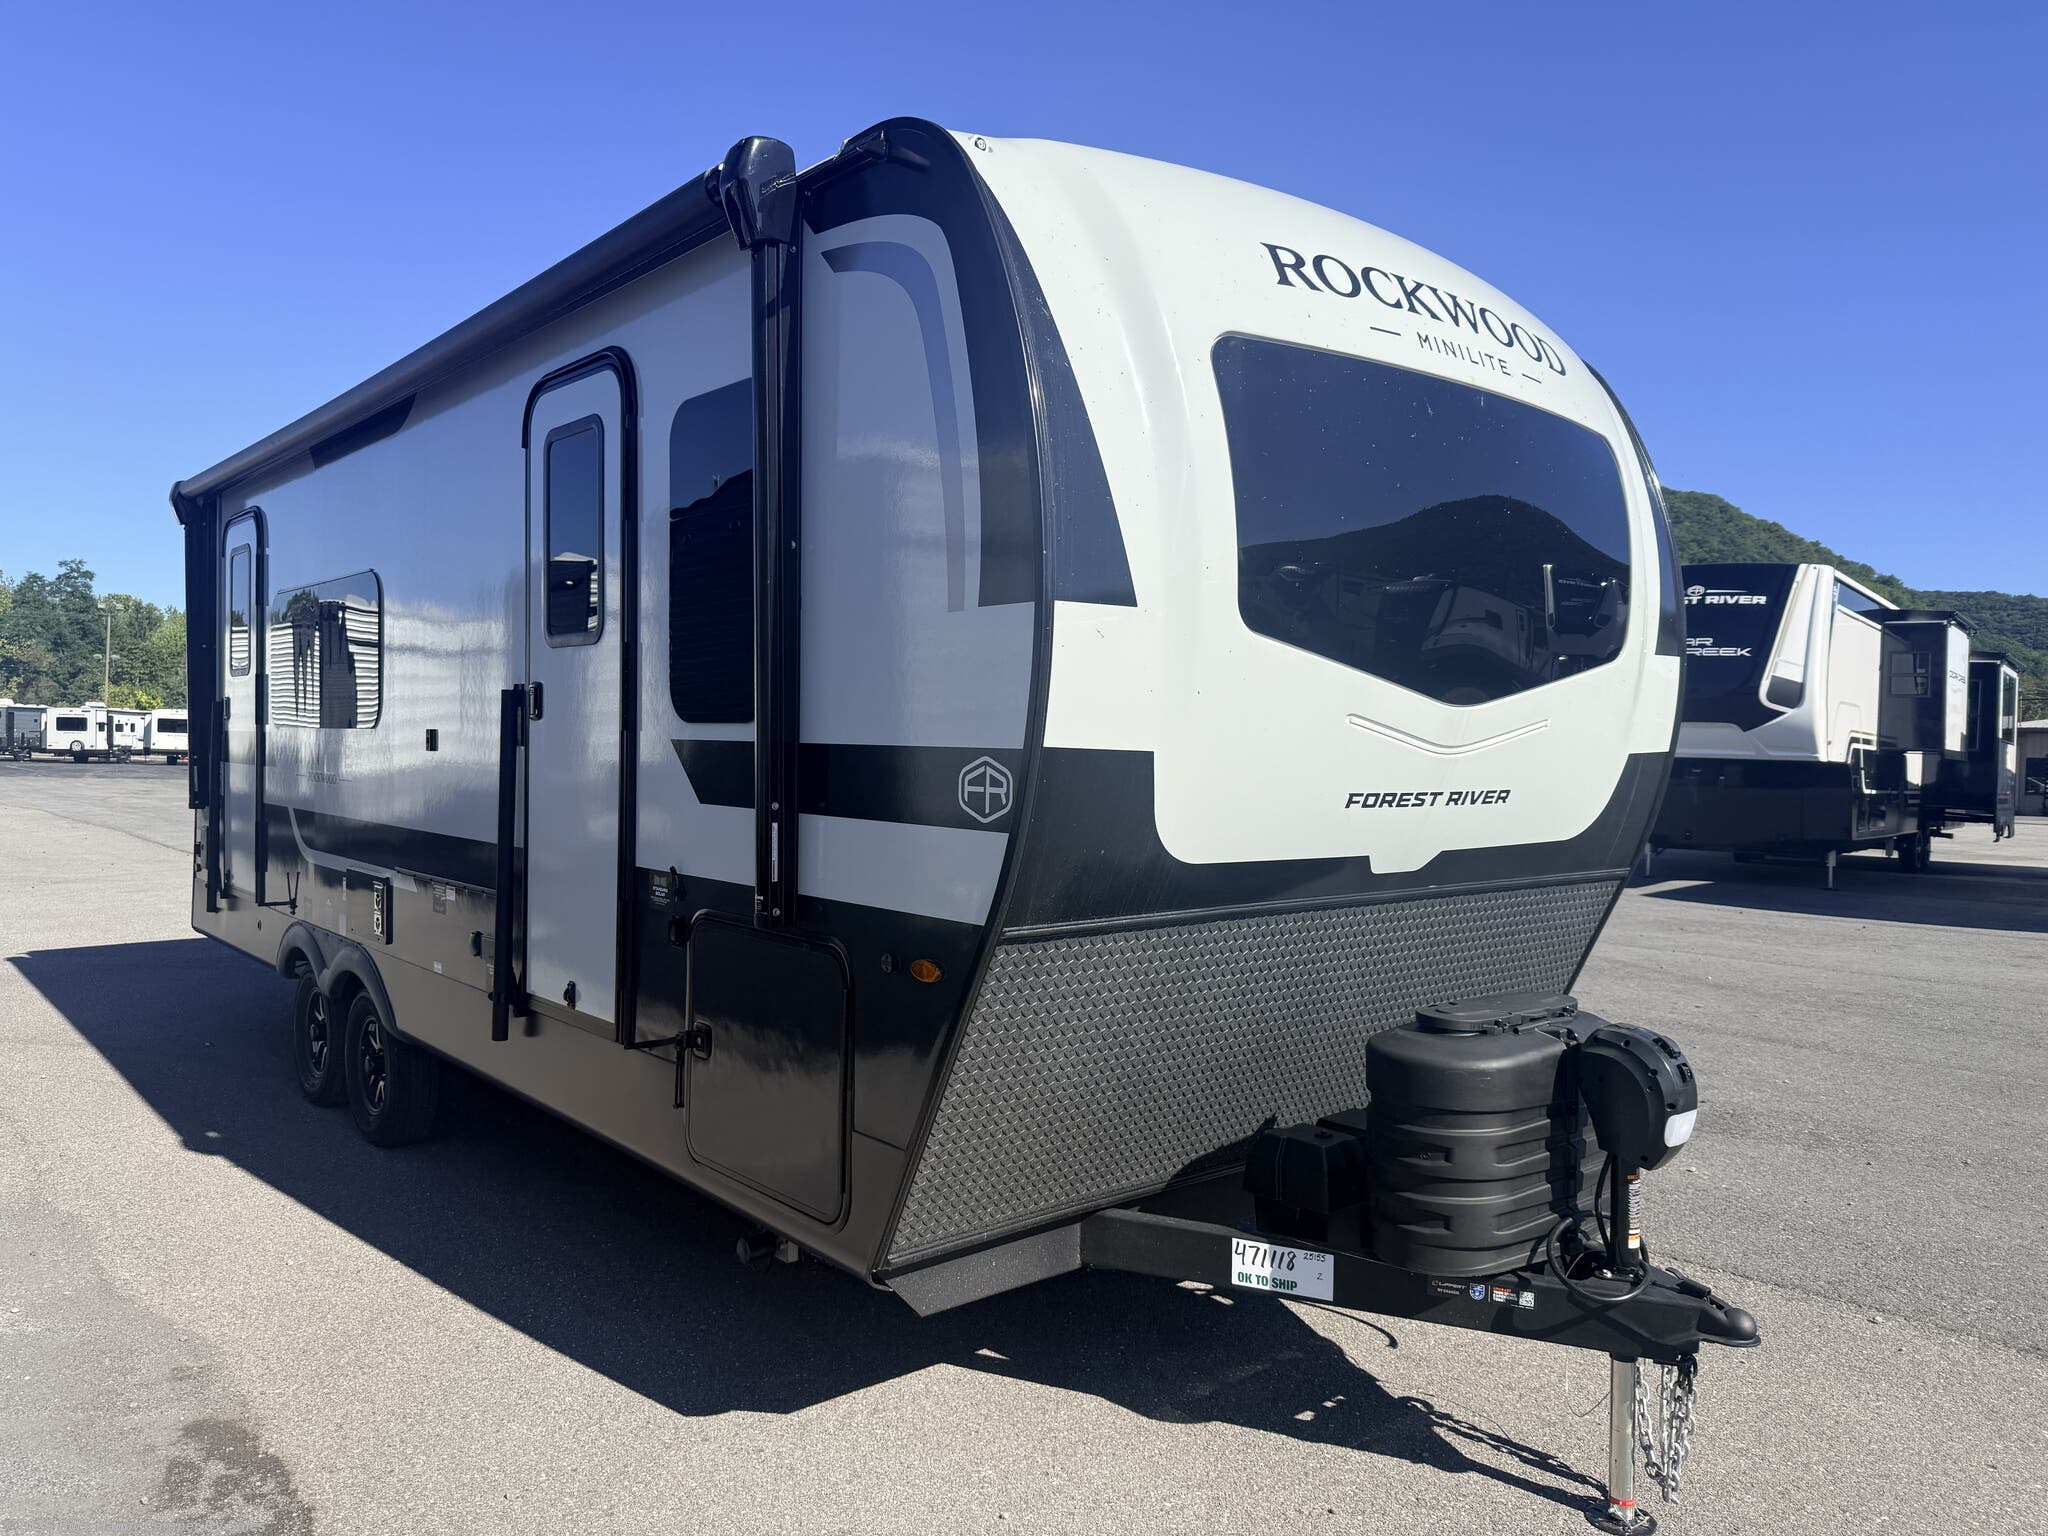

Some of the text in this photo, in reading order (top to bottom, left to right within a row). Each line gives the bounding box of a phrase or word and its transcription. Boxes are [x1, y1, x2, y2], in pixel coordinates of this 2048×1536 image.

[1260, 241, 1567, 377] ROCKWOOD
[1416, 331, 1512, 376] MINILITE
[1704, 595, 1767, 605] RIVER
[1345, 789, 1511, 809] FOREST RIVER
[1234, 1240, 1297, 1272] 471118
[1237, 1271, 1298, 1291] OK TO SHIP
